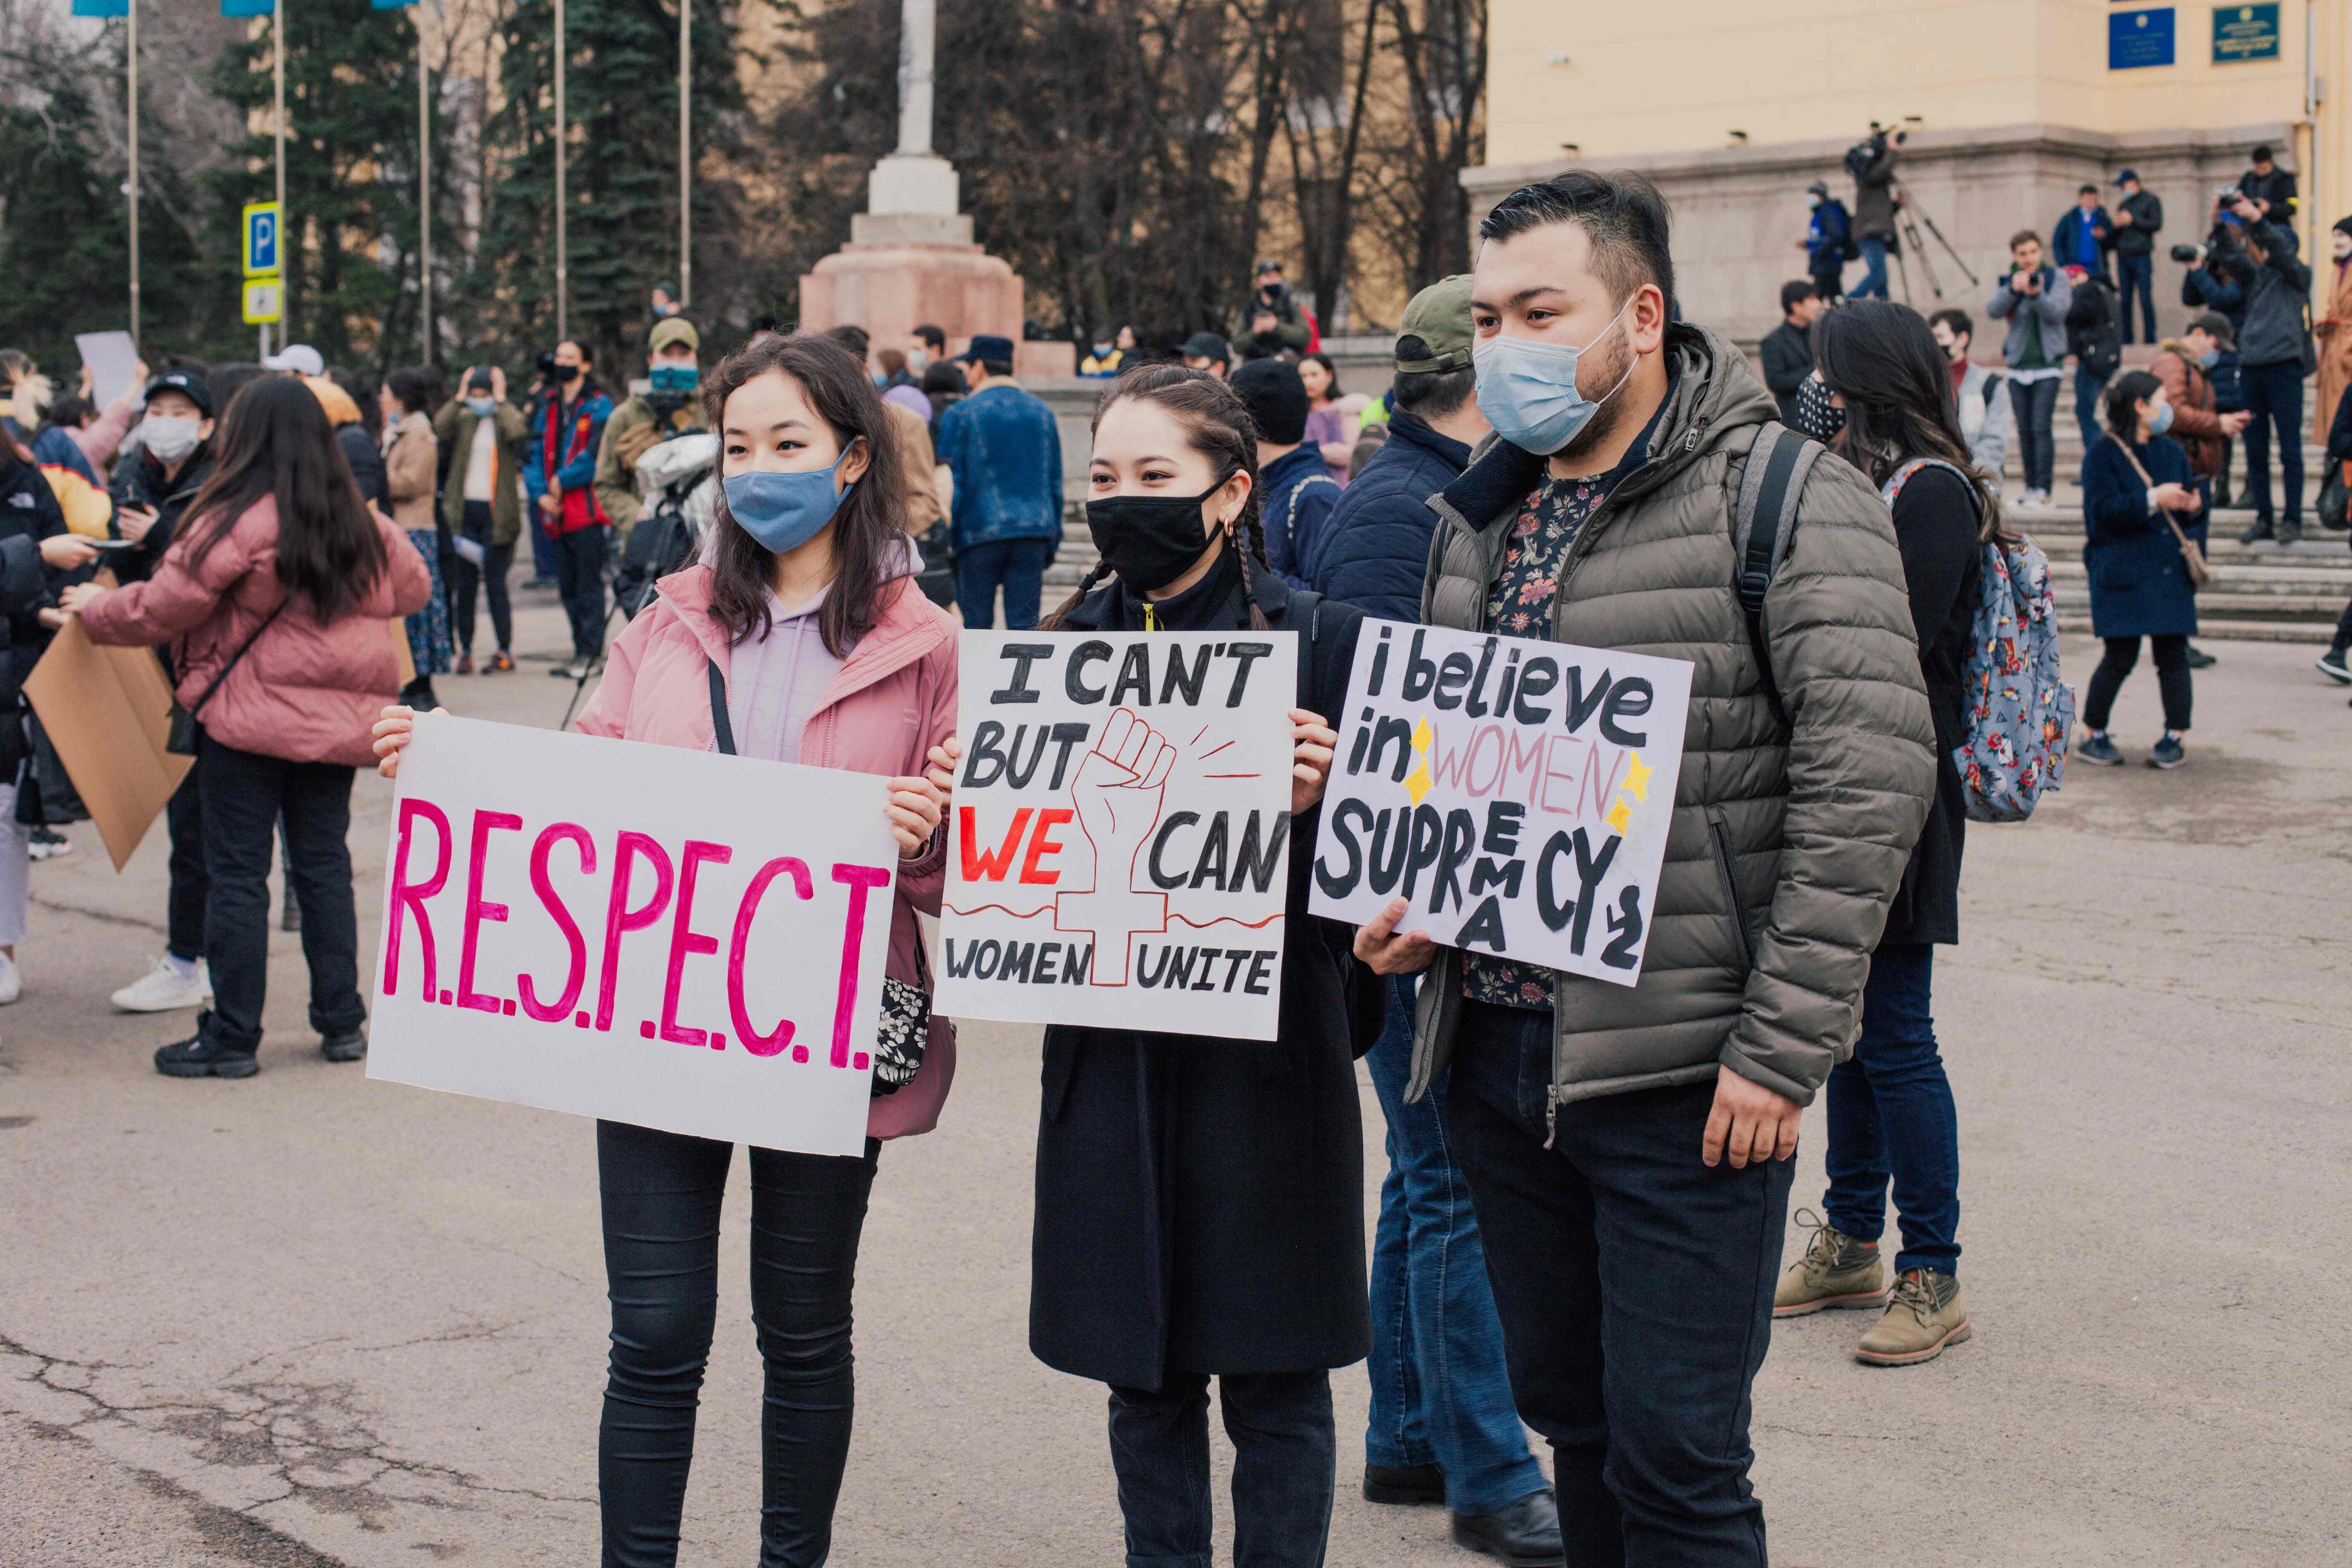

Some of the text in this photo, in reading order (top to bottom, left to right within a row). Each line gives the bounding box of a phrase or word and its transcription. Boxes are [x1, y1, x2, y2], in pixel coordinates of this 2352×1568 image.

[256, 217, 272, 260] P
[990, 640, 1274, 708] I CAN'T
[1367, 626, 1653, 747] i believe
[960, 720, 1091, 790] BUT
[1347, 706, 1625, 821] in WOMEN
[959, 806, 1291, 893] WE CAN
[383, 798, 890, 1070] R.E.S.P.E.C.T.
[946, 938, 1278, 995] WOMEN UNITE
